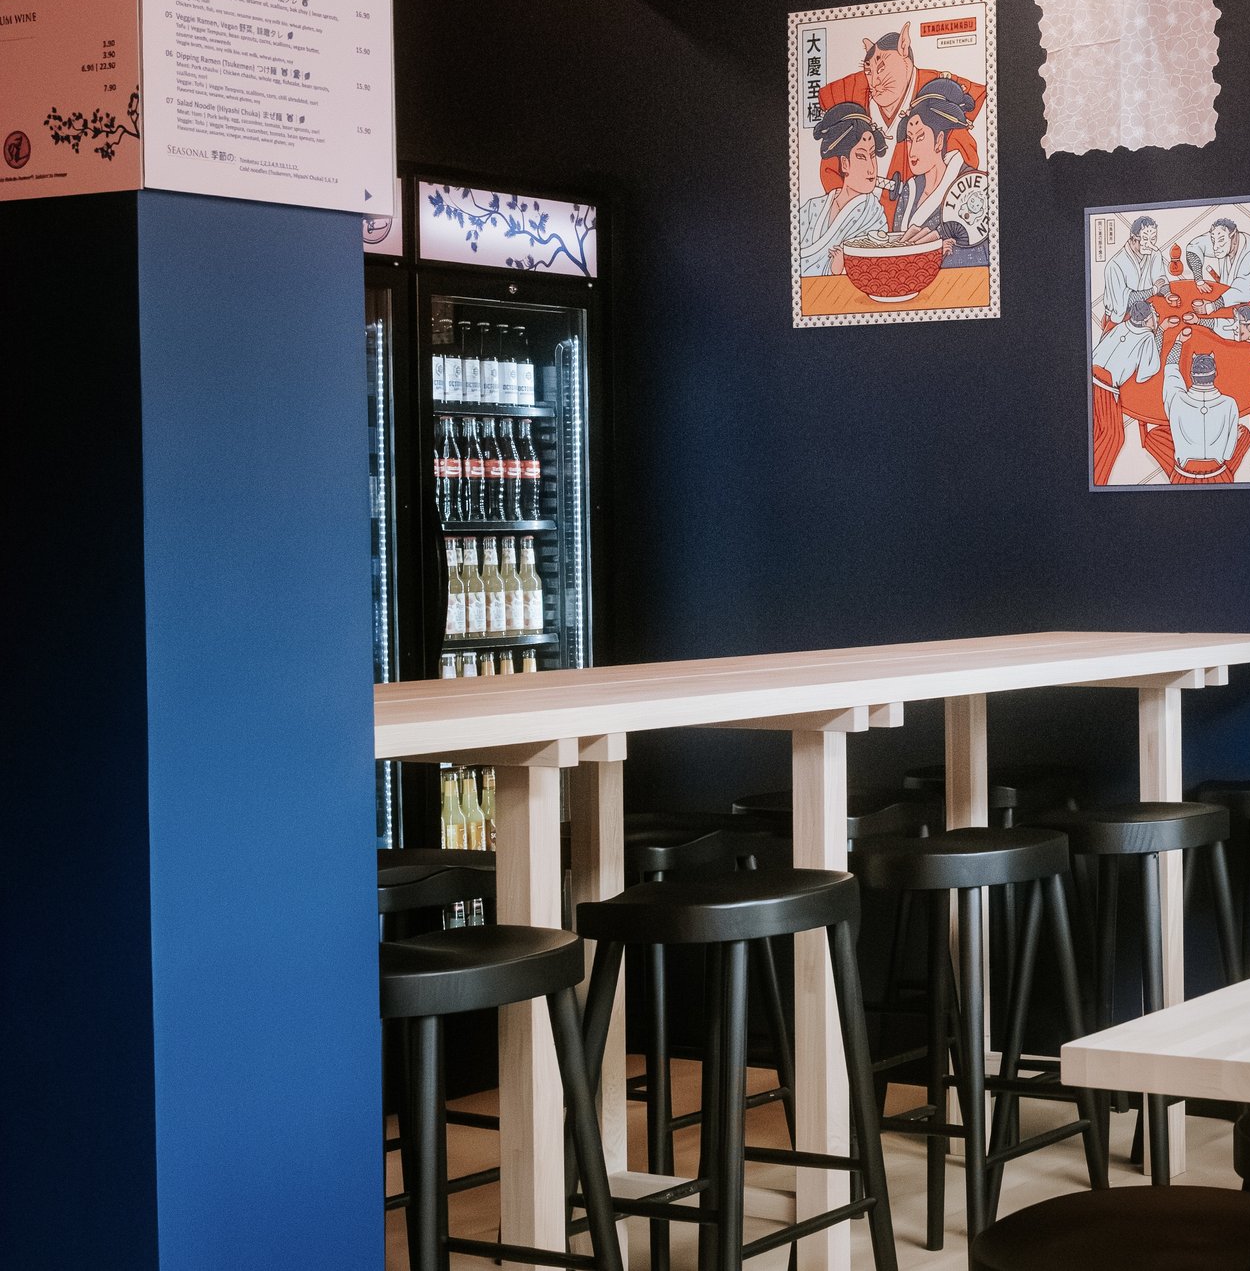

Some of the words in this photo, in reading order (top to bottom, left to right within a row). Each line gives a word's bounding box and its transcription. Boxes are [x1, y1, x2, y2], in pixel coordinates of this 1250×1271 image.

[14, 12, 37, 25] WINE
[164, 10, 172, 18] 05
[175, 12, 195, 24] Veggie
[196, 17, 218, 26] Ramen,
[220, 21, 238, 31] Vegan
[923, 20, 974, 34] ITADAKIMASU
[165, 49, 173, 57] 06
[176, 51, 199, 62] Dipping
[200, 56, 220, 65] Ramen
[222, 59, 254, 71] (Tsukemen)
[165, 96, 173, 104] 07
[176, 98, 192, 107] Salad
[194, 101, 215, 110] Noodle
[240, 108, 260, 117] Chuka)
[167, 145, 208, 158] SEASONAL
[946, 201, 955, 210] I
[951, 176, 982, 200] LOVE
